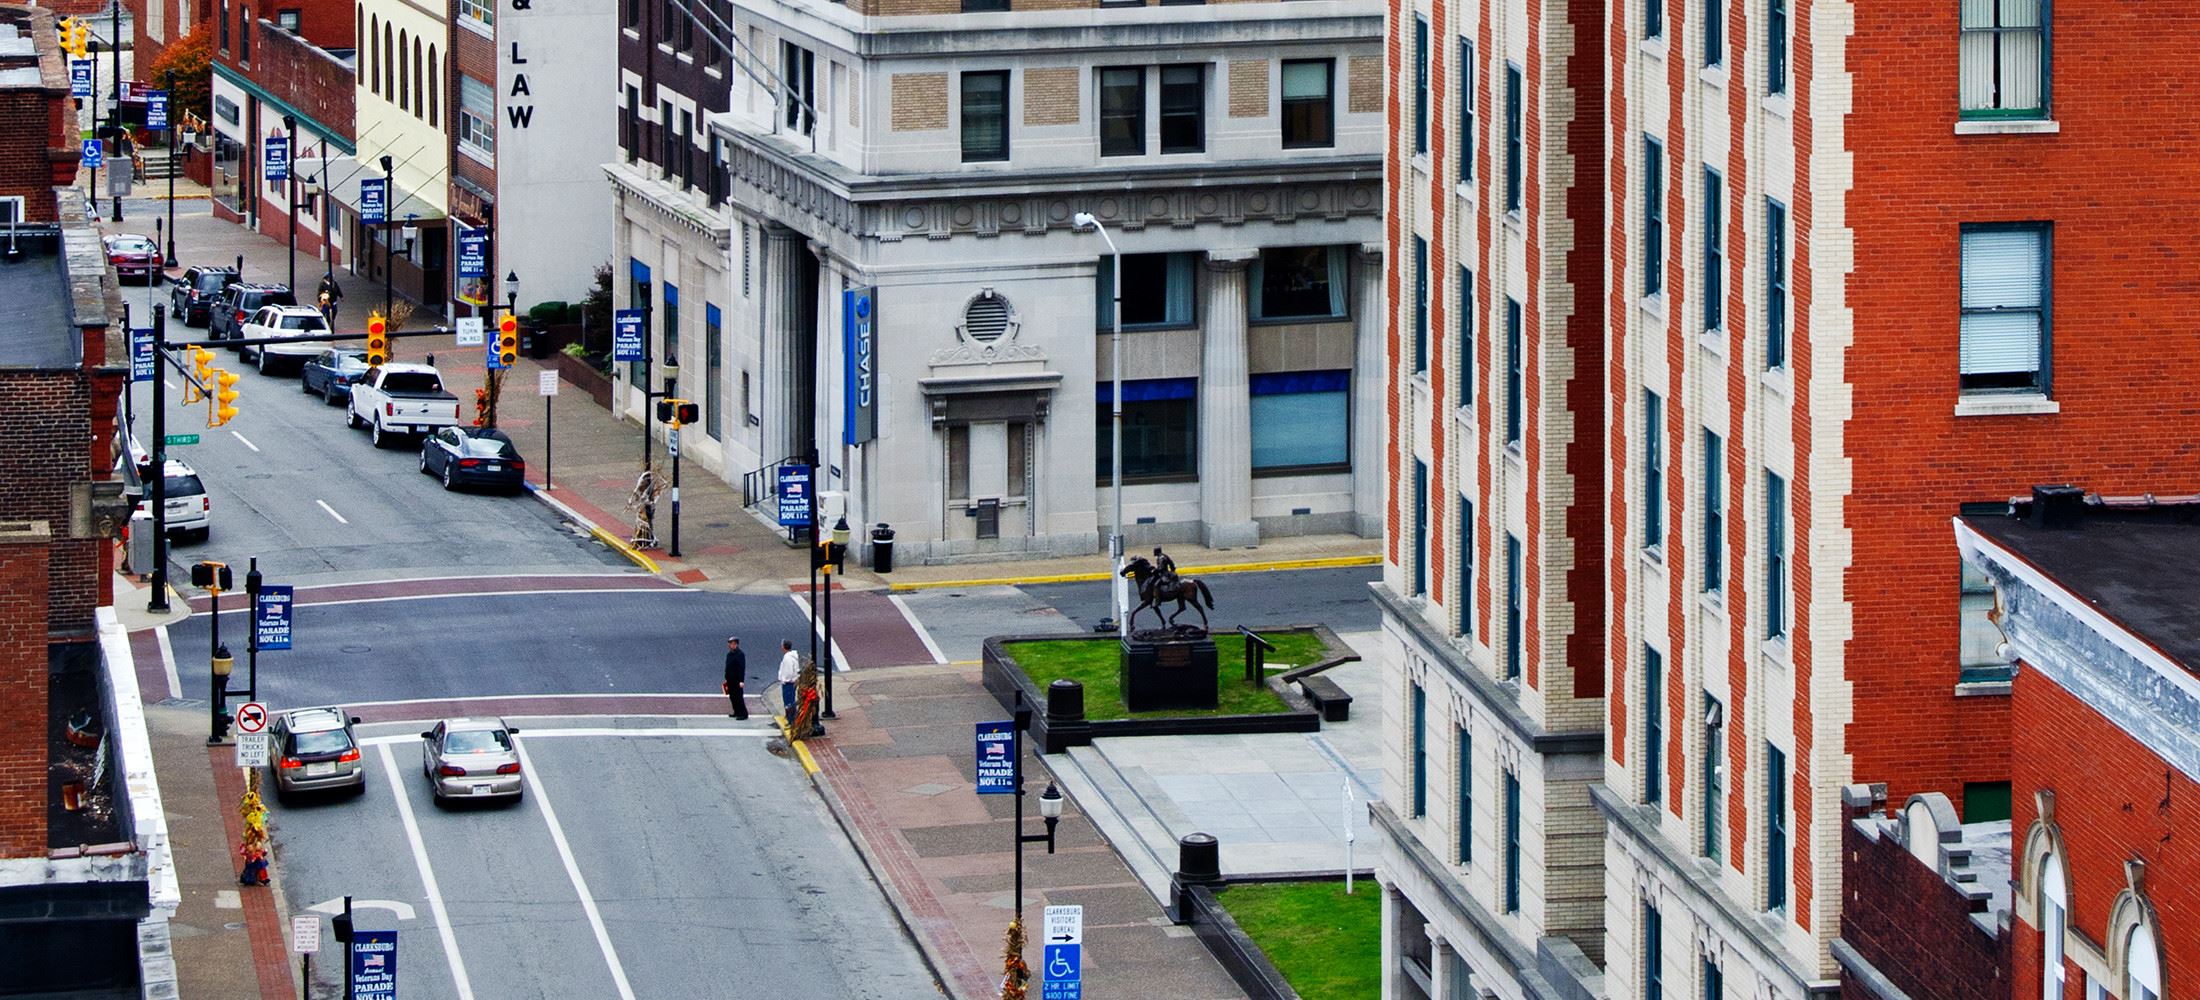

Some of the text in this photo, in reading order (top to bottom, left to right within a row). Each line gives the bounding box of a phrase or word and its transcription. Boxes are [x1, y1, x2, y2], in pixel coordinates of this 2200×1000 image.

[507, 42, 533, 128] LAW
[860, 321, 870, 407] CHASE
[258, 627, 290, 635] PARADE
[977, 732, 1012, 741] CLARKSBURG
[1002, 760, 1012, 768] Day
[1046, 907, 1081, 916] CLARKSBURG
[1051, 916, 1076, 924] VISITORS
[1052, 926, 1075, 934] BUREAU
[354, 942, 394, 952] CLARKSBURG
[355, 972, 393, 983] Veterans Day
[354, 982, 394, 992] PARADE
[1063, 992, 1078, 1000] FINE
